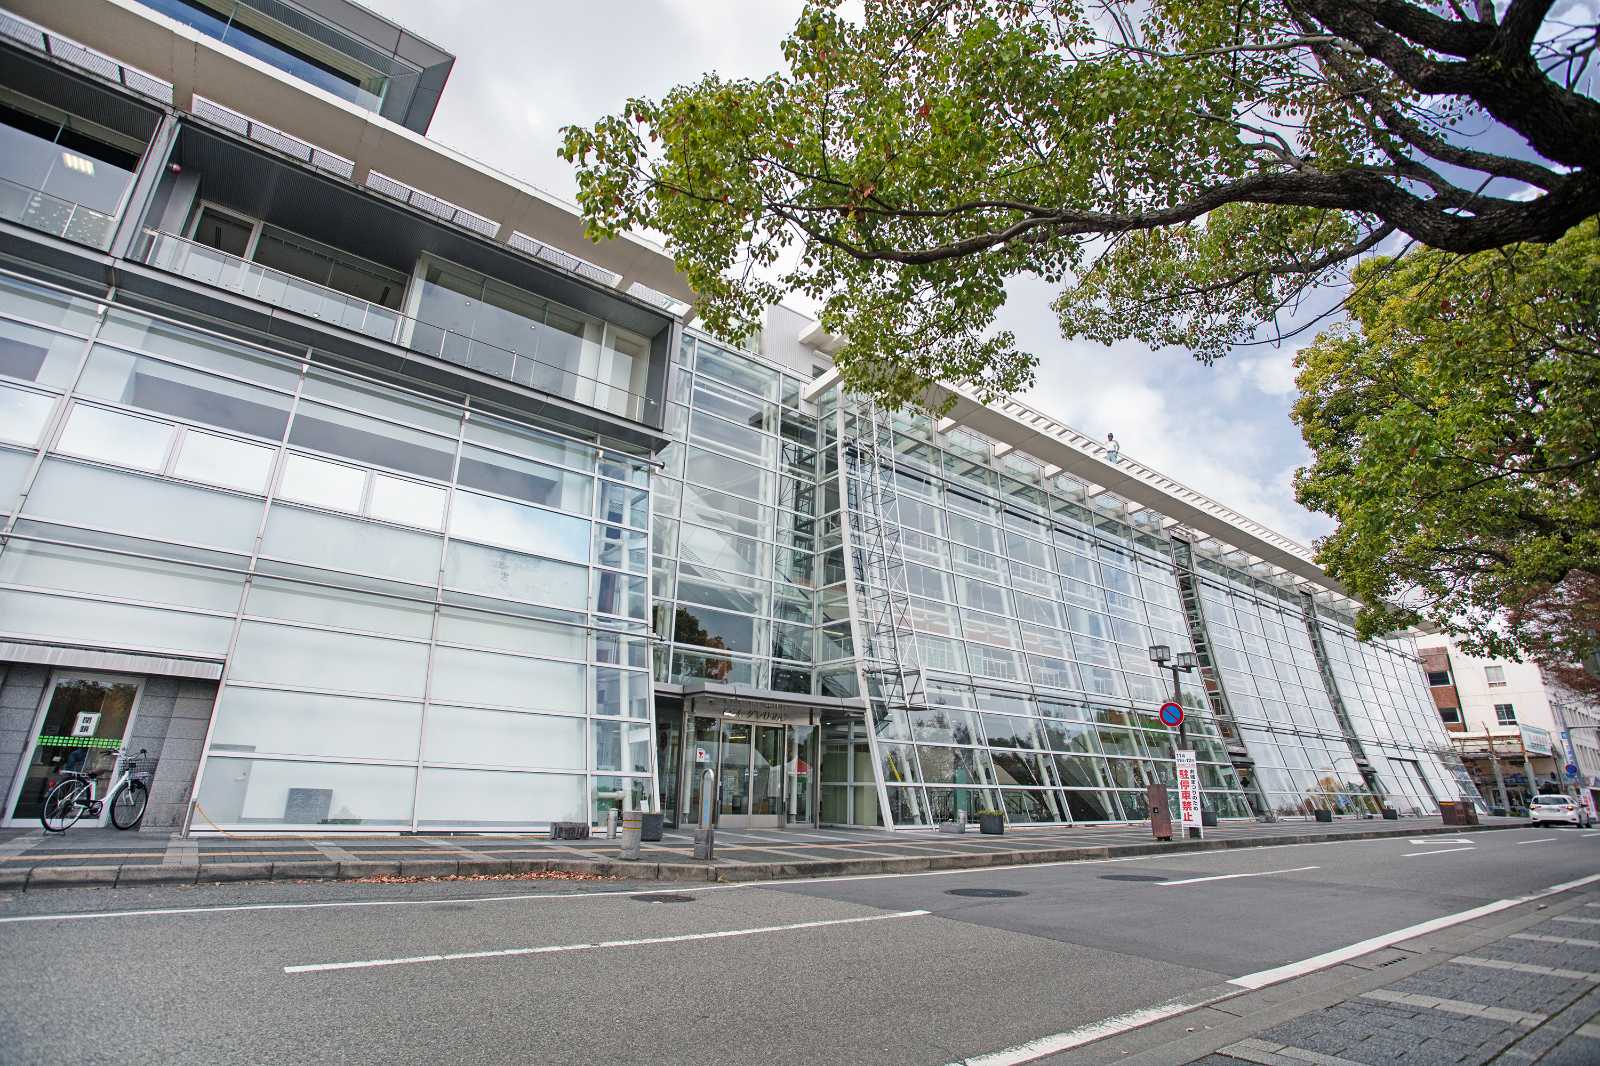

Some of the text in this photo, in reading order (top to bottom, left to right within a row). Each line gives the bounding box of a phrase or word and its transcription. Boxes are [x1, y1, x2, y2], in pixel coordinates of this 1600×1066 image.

[1179, 769, 1193, 822] 駐停車禁止
